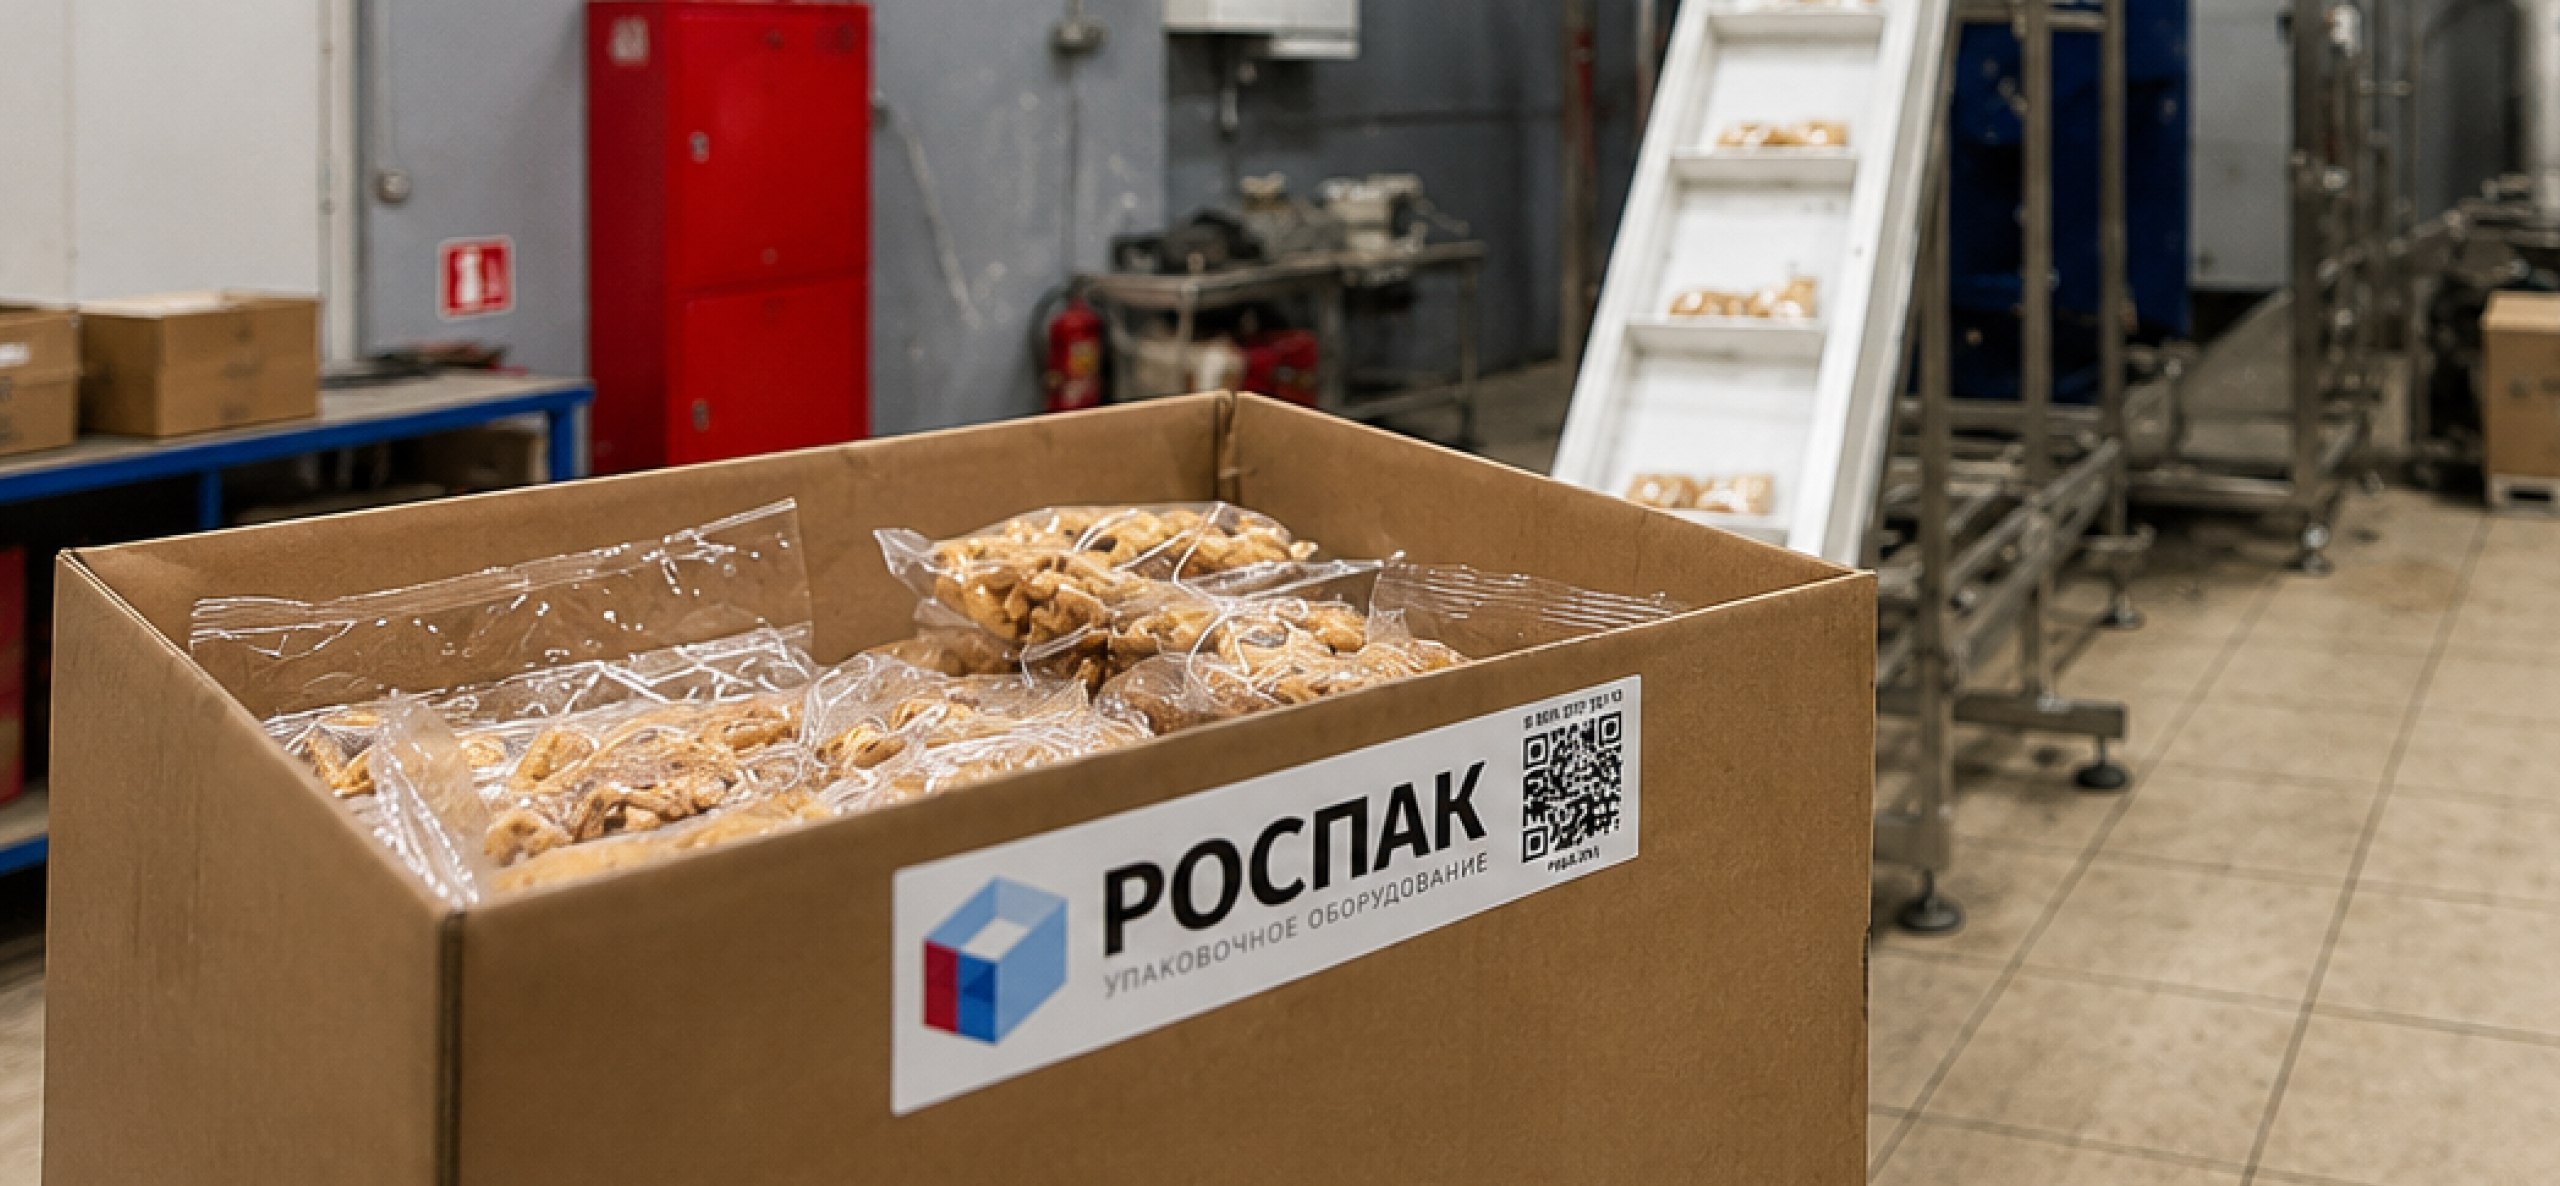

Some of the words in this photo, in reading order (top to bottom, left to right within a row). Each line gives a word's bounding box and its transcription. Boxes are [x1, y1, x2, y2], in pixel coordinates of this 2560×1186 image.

[1103, 760, 1488, 958] РОСПАК
[1103, 915, 1298, 998] УПАКОВОЧНОЕ
[1307, 851, 1489, 930] ОБОРУДОВАНИЕ
